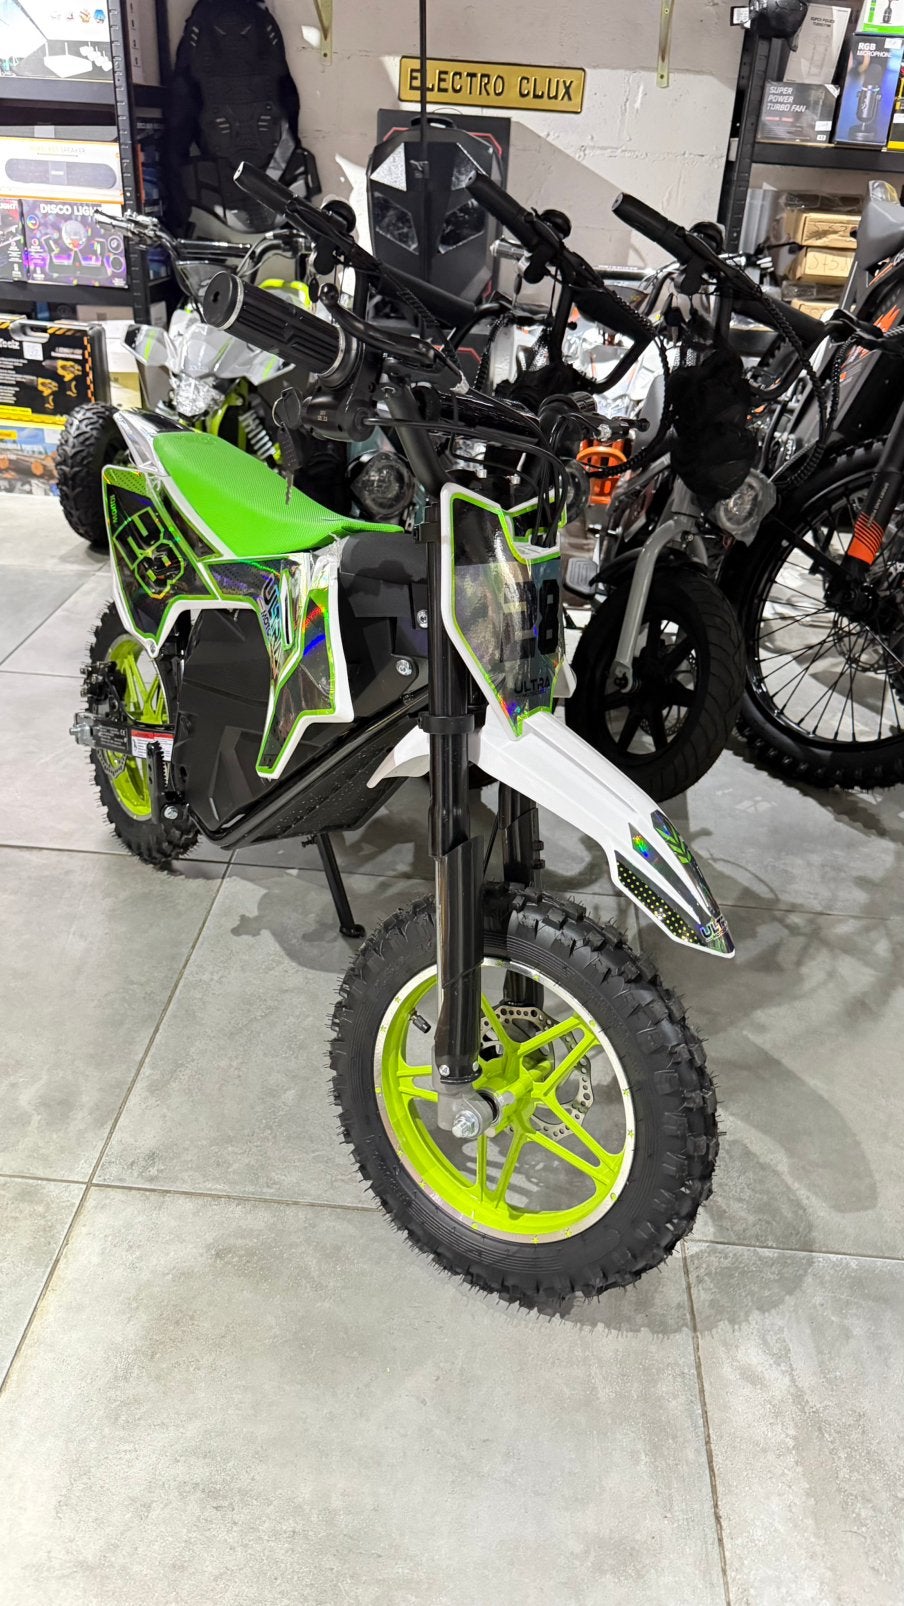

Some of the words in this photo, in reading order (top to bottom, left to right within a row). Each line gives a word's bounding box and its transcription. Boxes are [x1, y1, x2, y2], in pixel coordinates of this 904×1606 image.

[858, 42, 877, 51] RGB
[408, 68, 505, 97] ELECTRO
[518, 75, 574, 102] CLUX
[769, 86, 793, 95] SUPER
[767, 94, 794, 103] POWER
[766, 103, 791, 112] TURBO
[790, 104, 806, 113] FAN
[40, 203, 72, 215] DISCO
[113, 506, 185, 599] 28
[501, 579, 560, 662] 28
